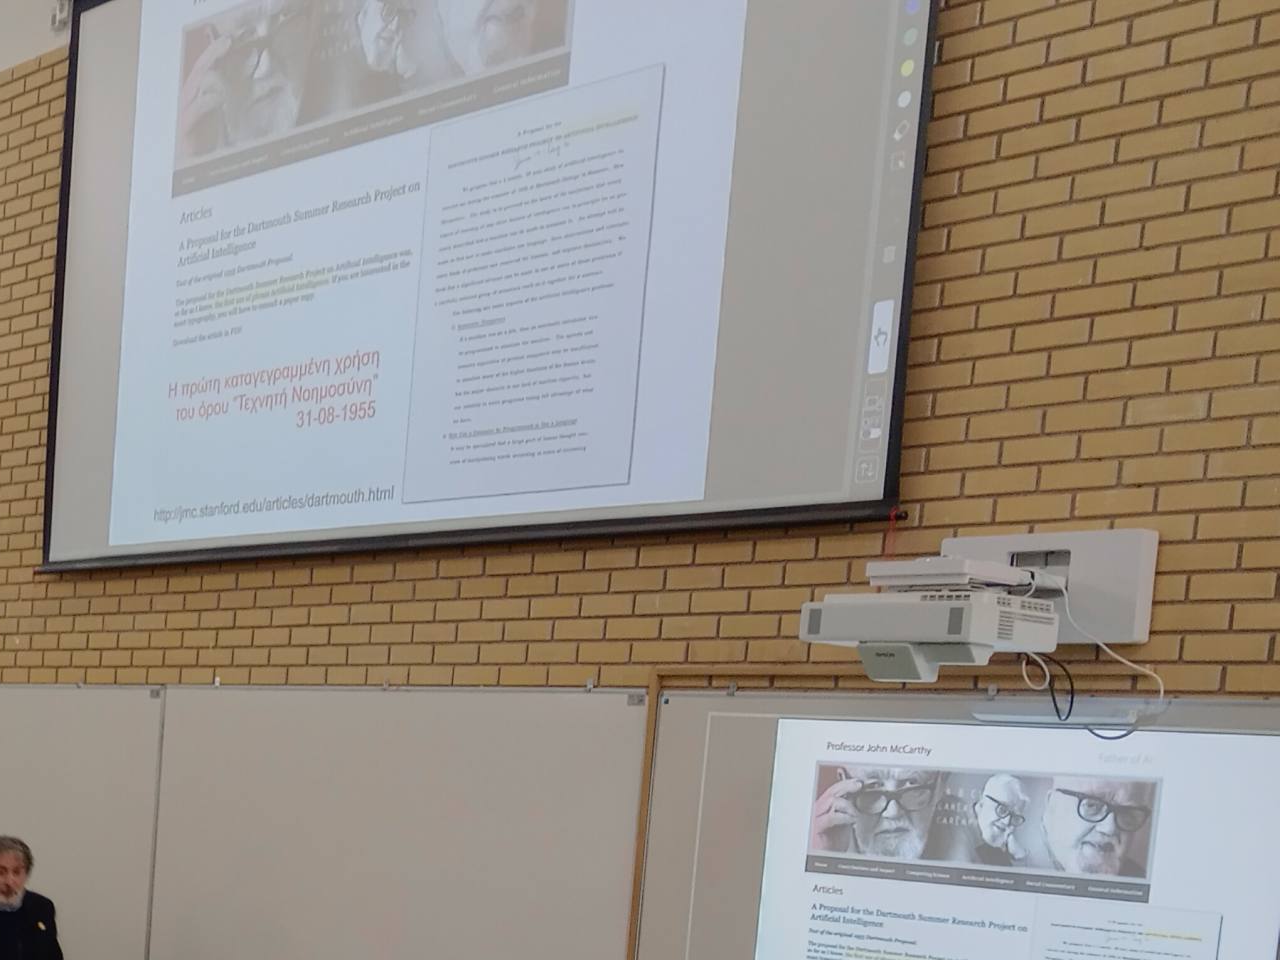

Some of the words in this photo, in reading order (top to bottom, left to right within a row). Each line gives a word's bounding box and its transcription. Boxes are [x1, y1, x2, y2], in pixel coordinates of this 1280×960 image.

[179, 207, 213, 224] Articles
[186, 231, 219, 250] Proposal
[220, 229, 231, 241] for
[233, 225, 246, 237] the
[247, 212, 293, 234] Dartmouth
[294, 204, 330, 222] Summer
[331, 191, 372, 213] Research
[374, 183, 407, 202] Project
[408, 181, 421, 193] on
[177, 247, 209, 267] Artificial
[211, 240, 256, 259] Intelligence
[181, 376, 221, 399] πρώτη
[224, 356, 331, 390] καταγεγραμμένη
[334, 350, 380, 376] χρήση
[176, 404, 195, 421] του
[198, 397, 229, 420] όρου
[296, 400, 376, 429] 31-08-1955
[153, 485, 395, 523] http://jmc.stanford.edu/articles/dartmouth.html
[826, 741, 865, 753] Professor
[867, 743, 888, 753] John
[889, 744, 932, 757] McCarthy
[812, 884, 844, 896] Articles
[810, 913, 841, 924] Artificial
[842, 916, 884, 928] Intelligence
[819, 904, 849, 915] Proposal
[850, 905, 861, 915] for
[862, 907, 875, 916] the
[875, 909, 917, 921] Dartmouth
[918, 913, 950, 924] Summer
[951, 916, 986, 929] Research
[988, 921, 1016, 933] Project
[1017, 925, 1028, 933] on
